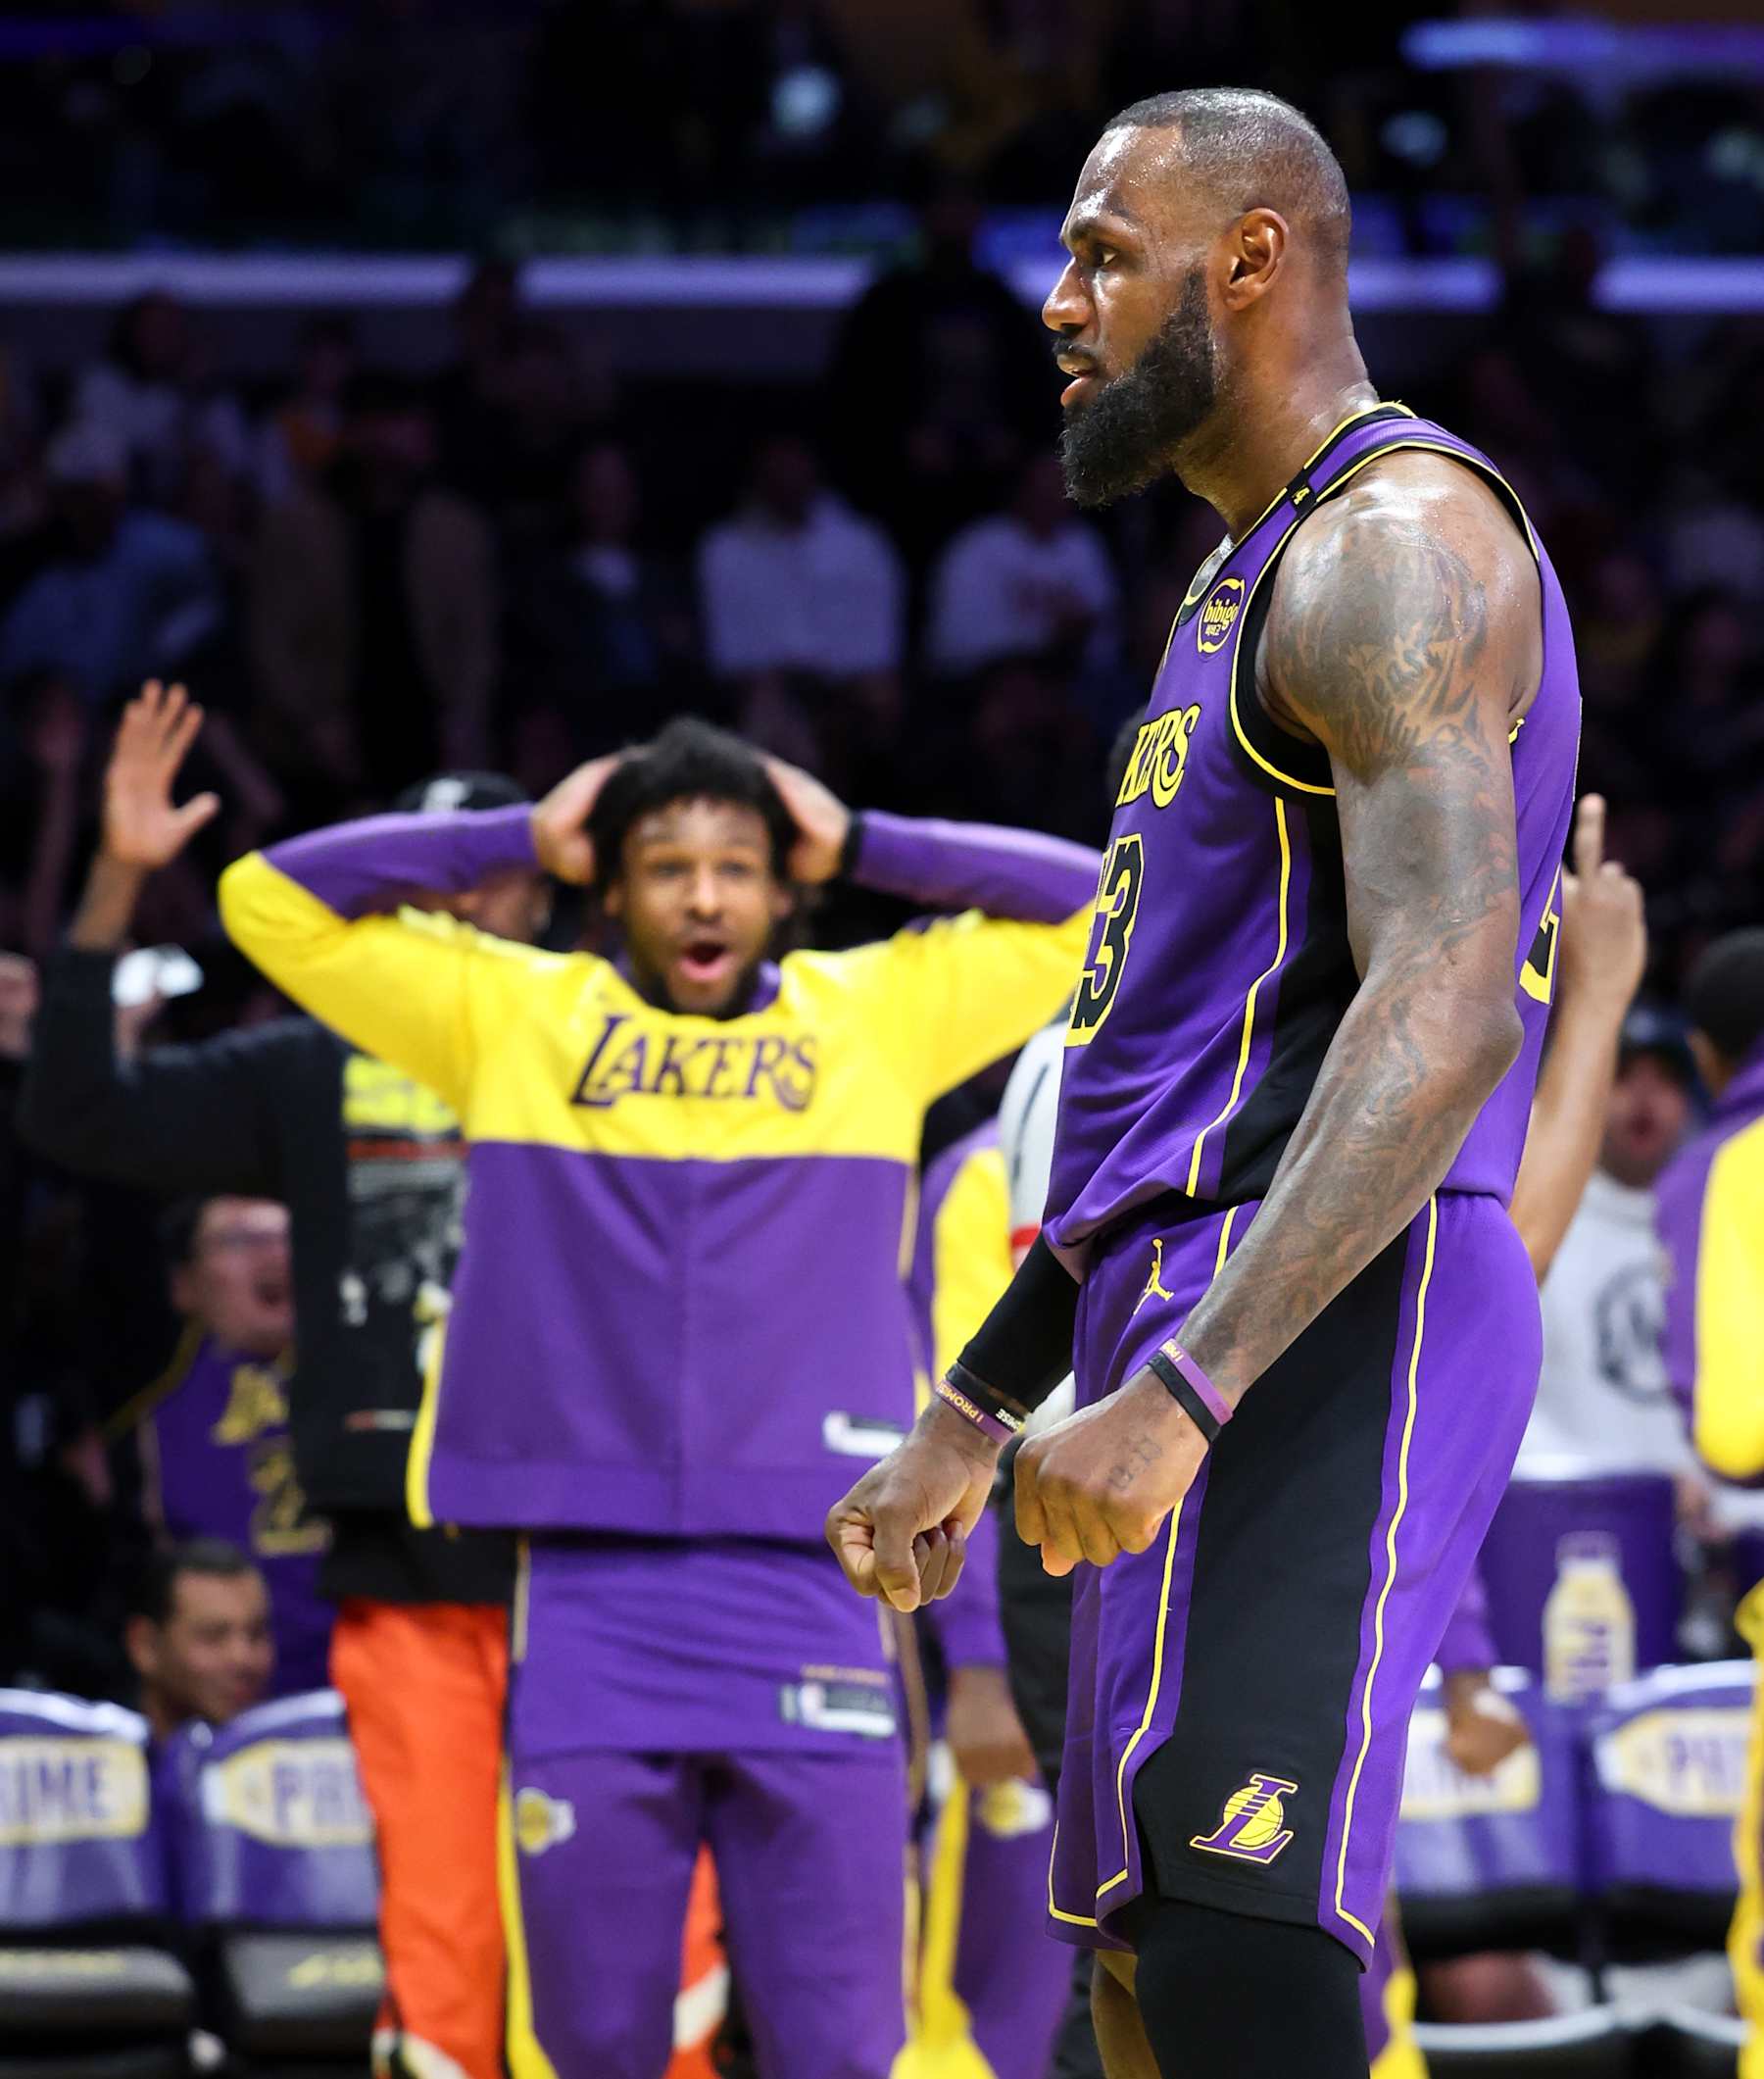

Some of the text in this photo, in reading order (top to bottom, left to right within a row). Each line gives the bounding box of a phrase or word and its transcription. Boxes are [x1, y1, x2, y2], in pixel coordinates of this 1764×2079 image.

[1203, 598, 1240, 631] bibigo
[565, 1014, 816, 1114] LAKERS
[975, 1412, 984, 1423] I
